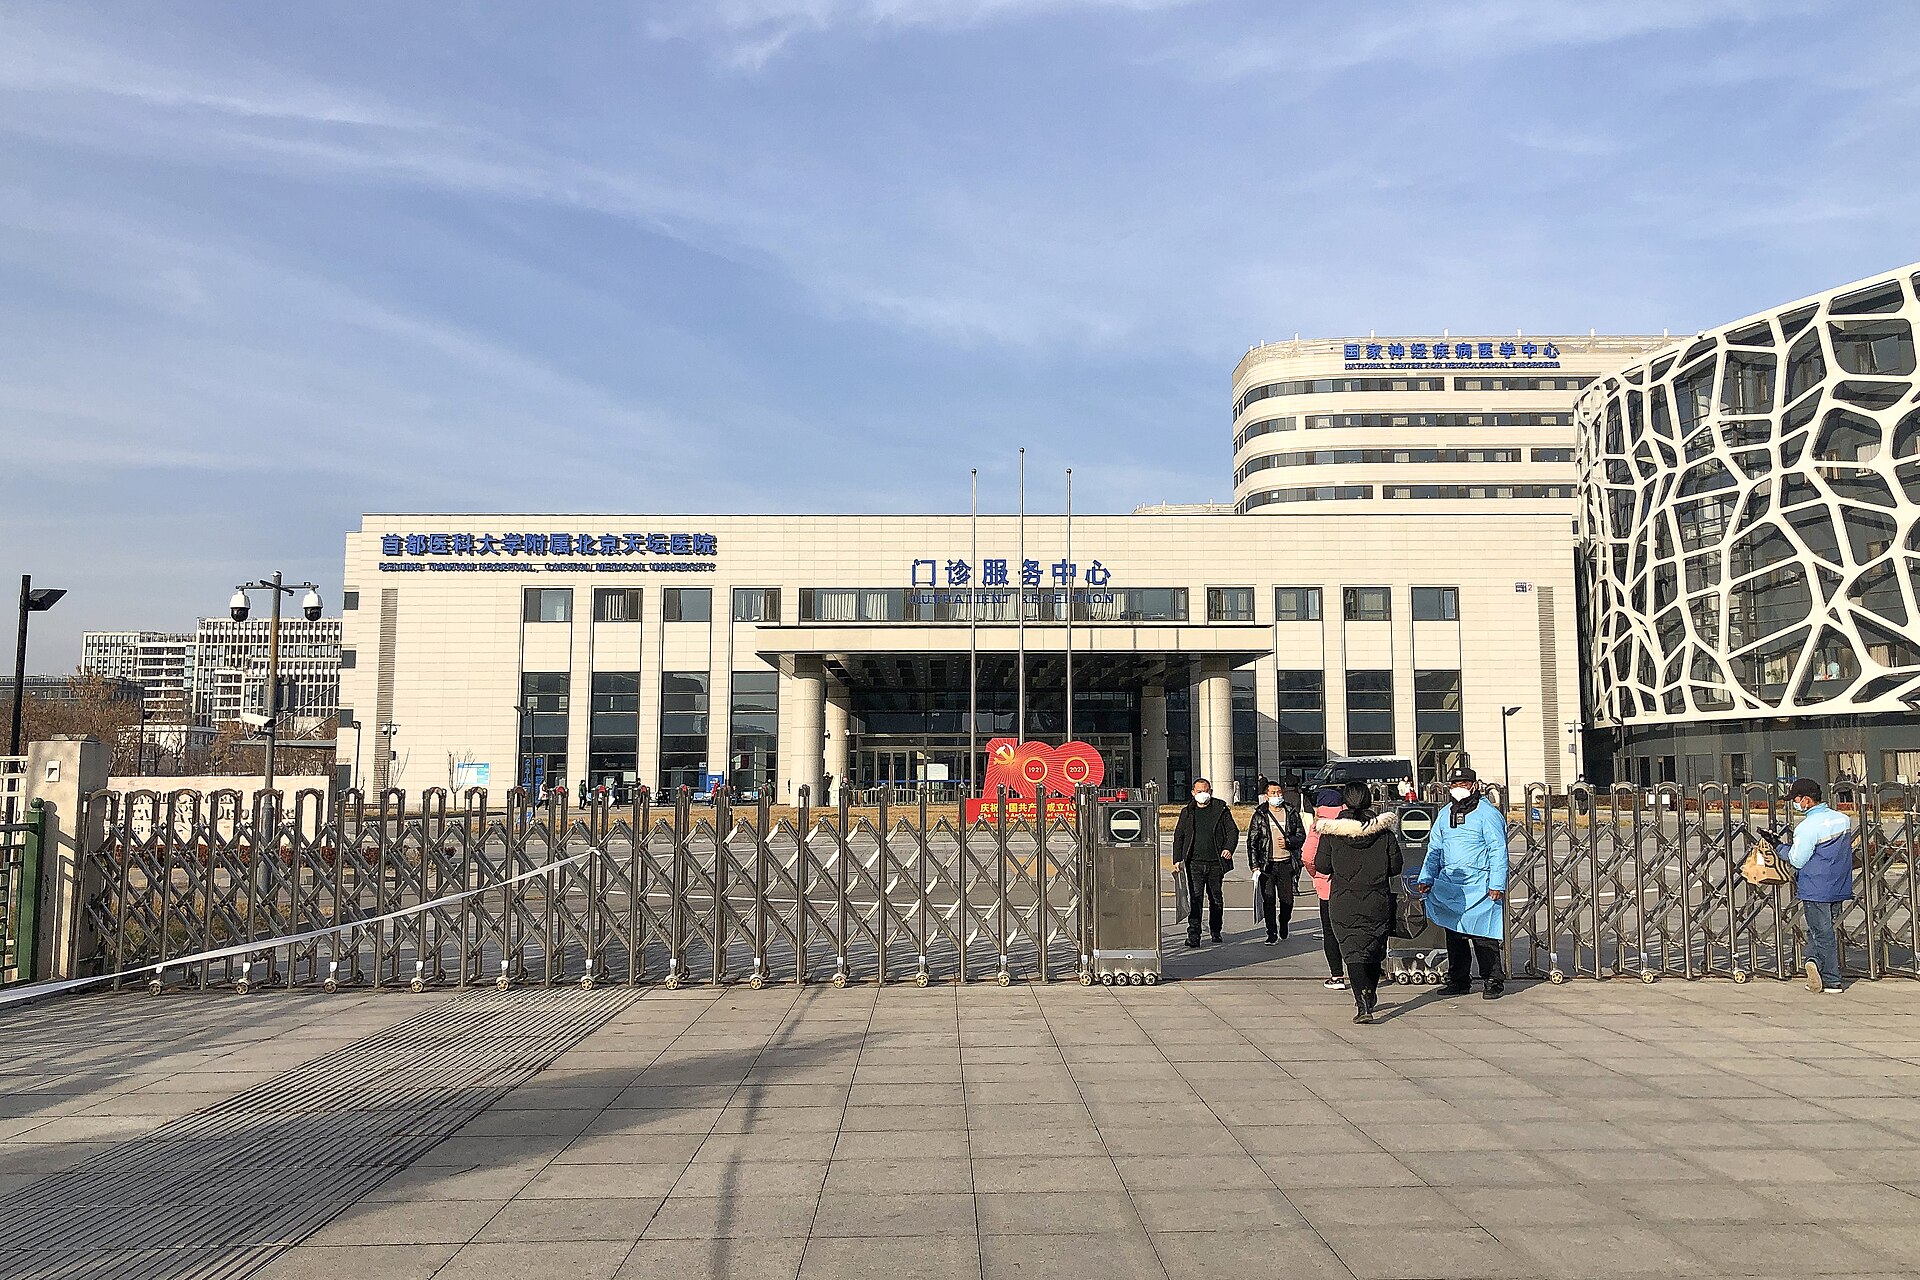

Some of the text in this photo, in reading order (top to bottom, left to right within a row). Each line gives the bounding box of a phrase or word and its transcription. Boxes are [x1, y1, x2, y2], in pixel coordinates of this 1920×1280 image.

[1344, 342, 1560, 360] 国家神经疾病医学中心
[381, 533, 717, 556] 首都医科大学附属北京天坛医院
[911, 558, 1112, 586] 门诊服务中心
[910, 593, 1011, 604] OUTPATIENT
